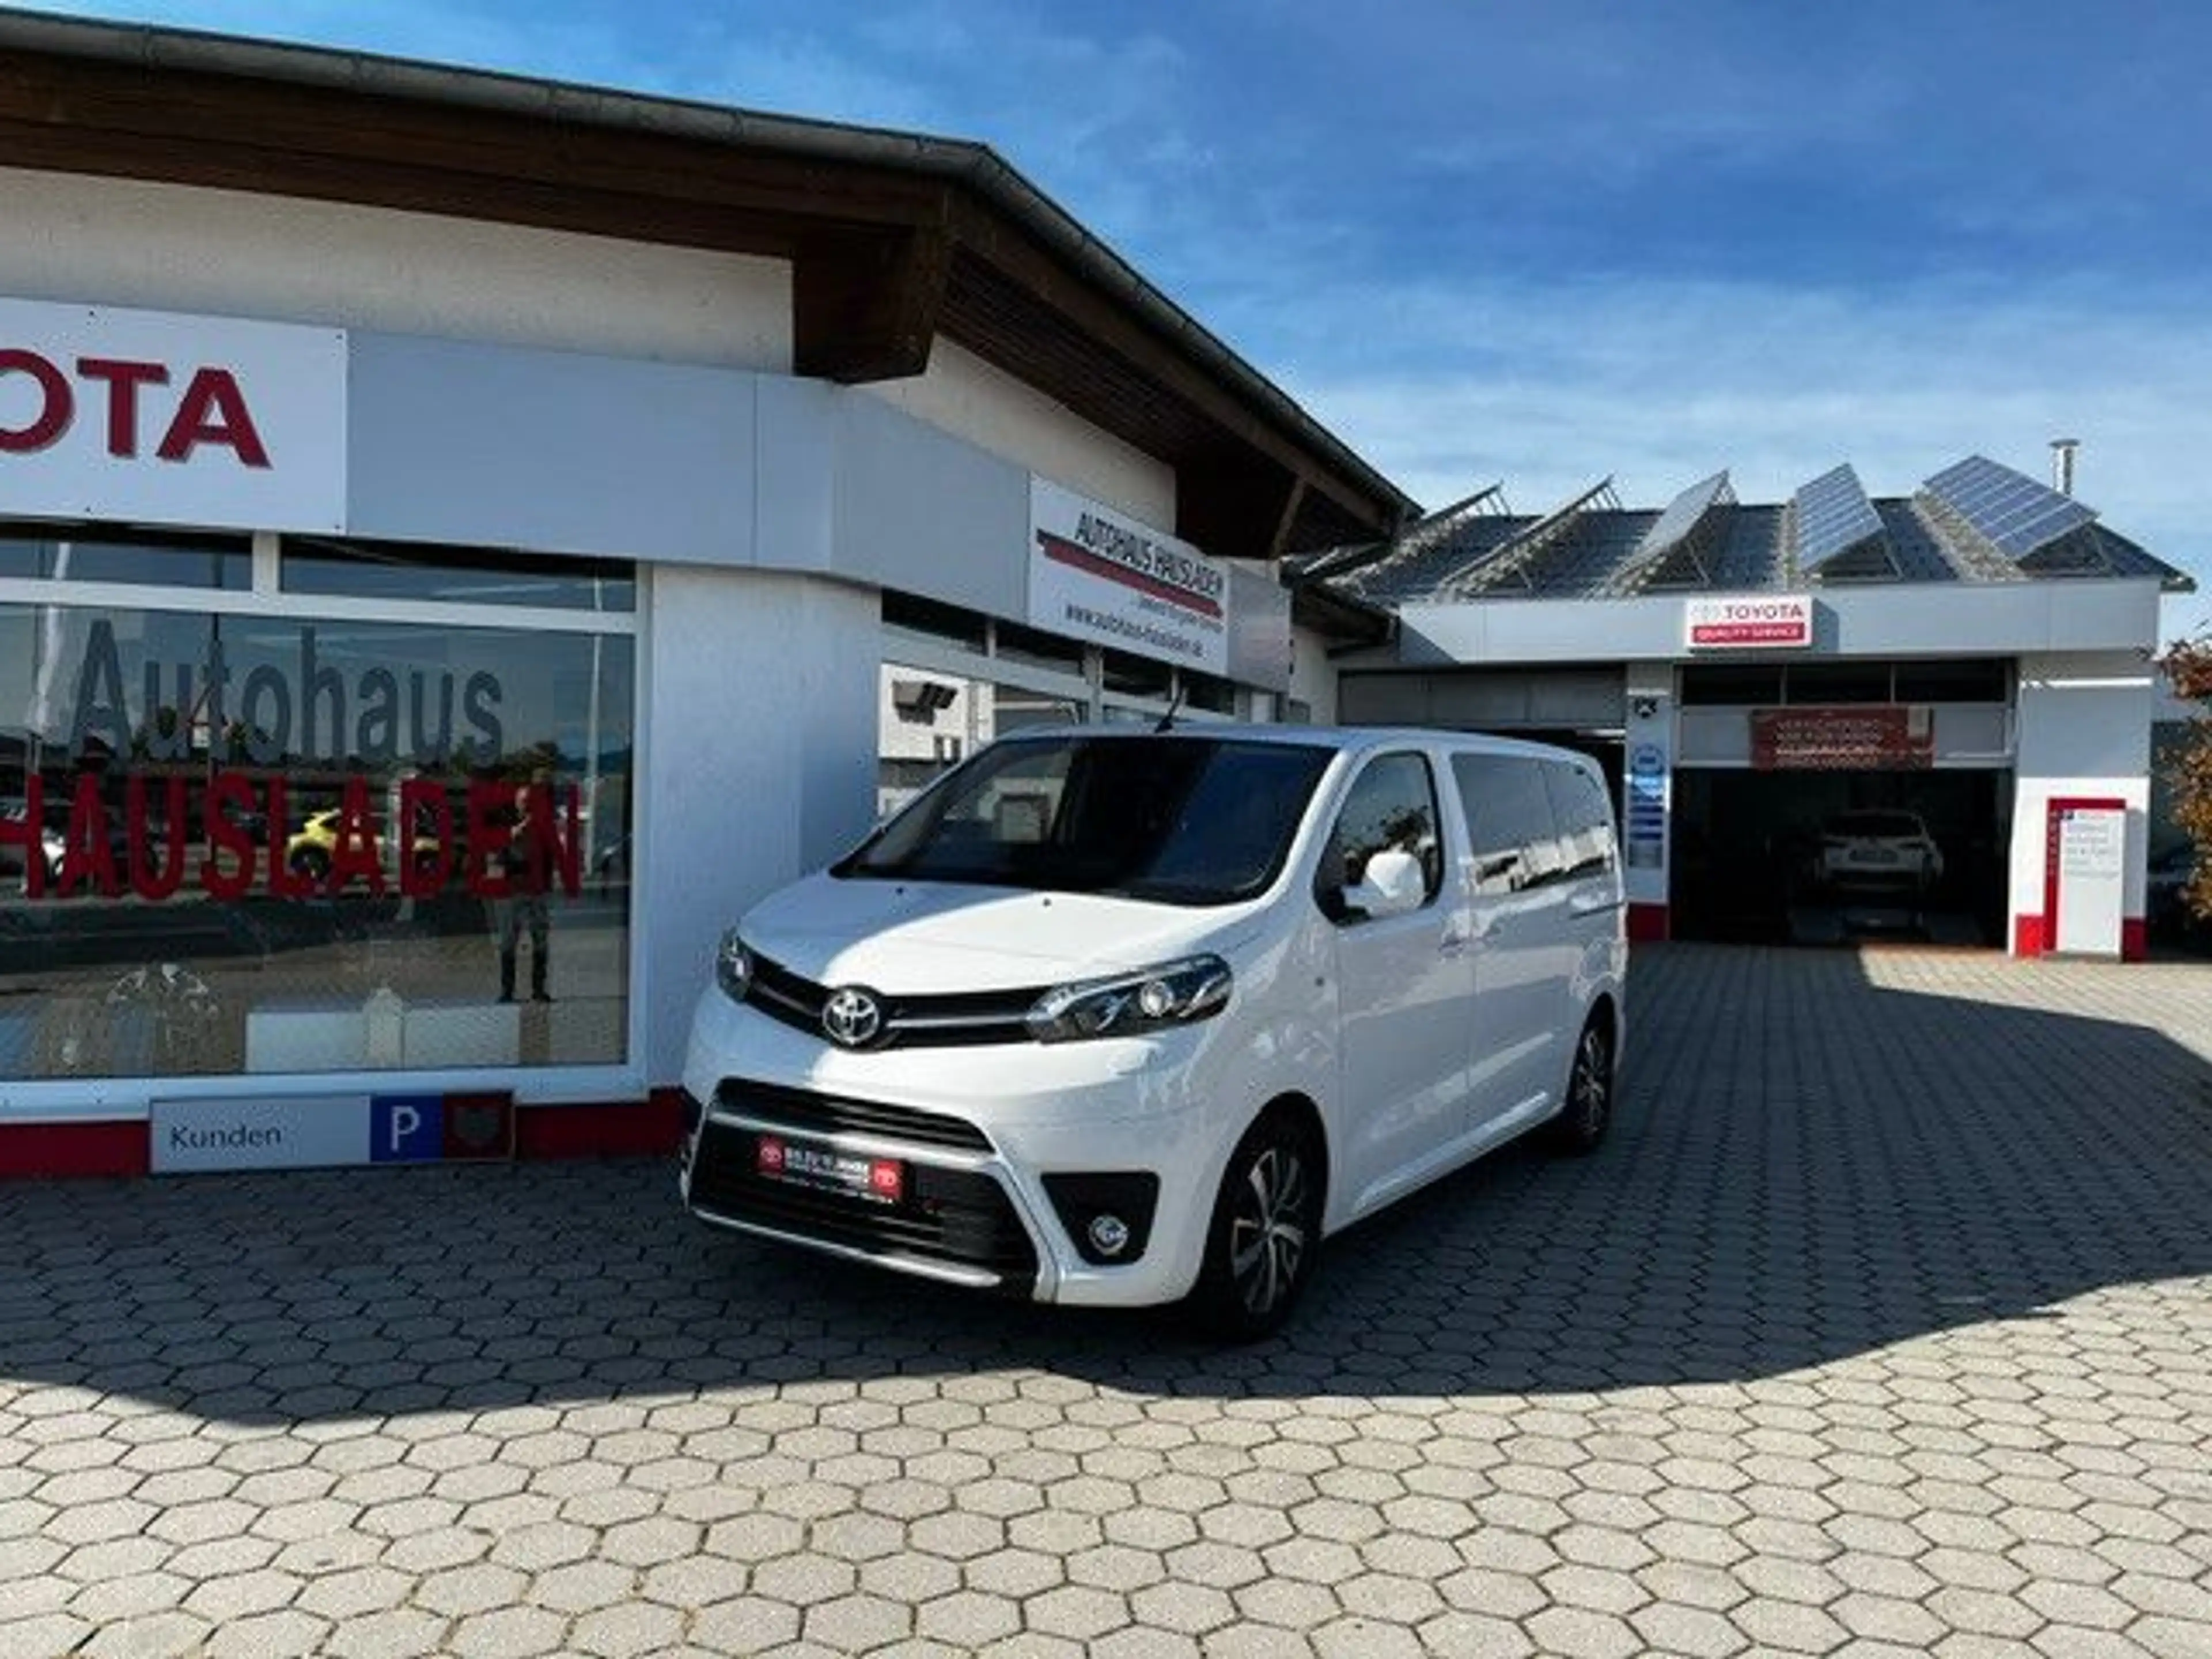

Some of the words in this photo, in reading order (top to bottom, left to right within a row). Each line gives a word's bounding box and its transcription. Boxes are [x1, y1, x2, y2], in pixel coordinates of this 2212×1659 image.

[0, 349, 273, 469] OTA
[1075, 512, 1152, 572] AUTOHAUS
[1154, 543, 1224, 597] HAUSLADEN
[1725, 604, 1804, 619] TOYOTA
[69, 619, 503, 765] Autohaus
[171, 1126, 282, 1149] Kunden
[391, 1105, 421, 1151] P
